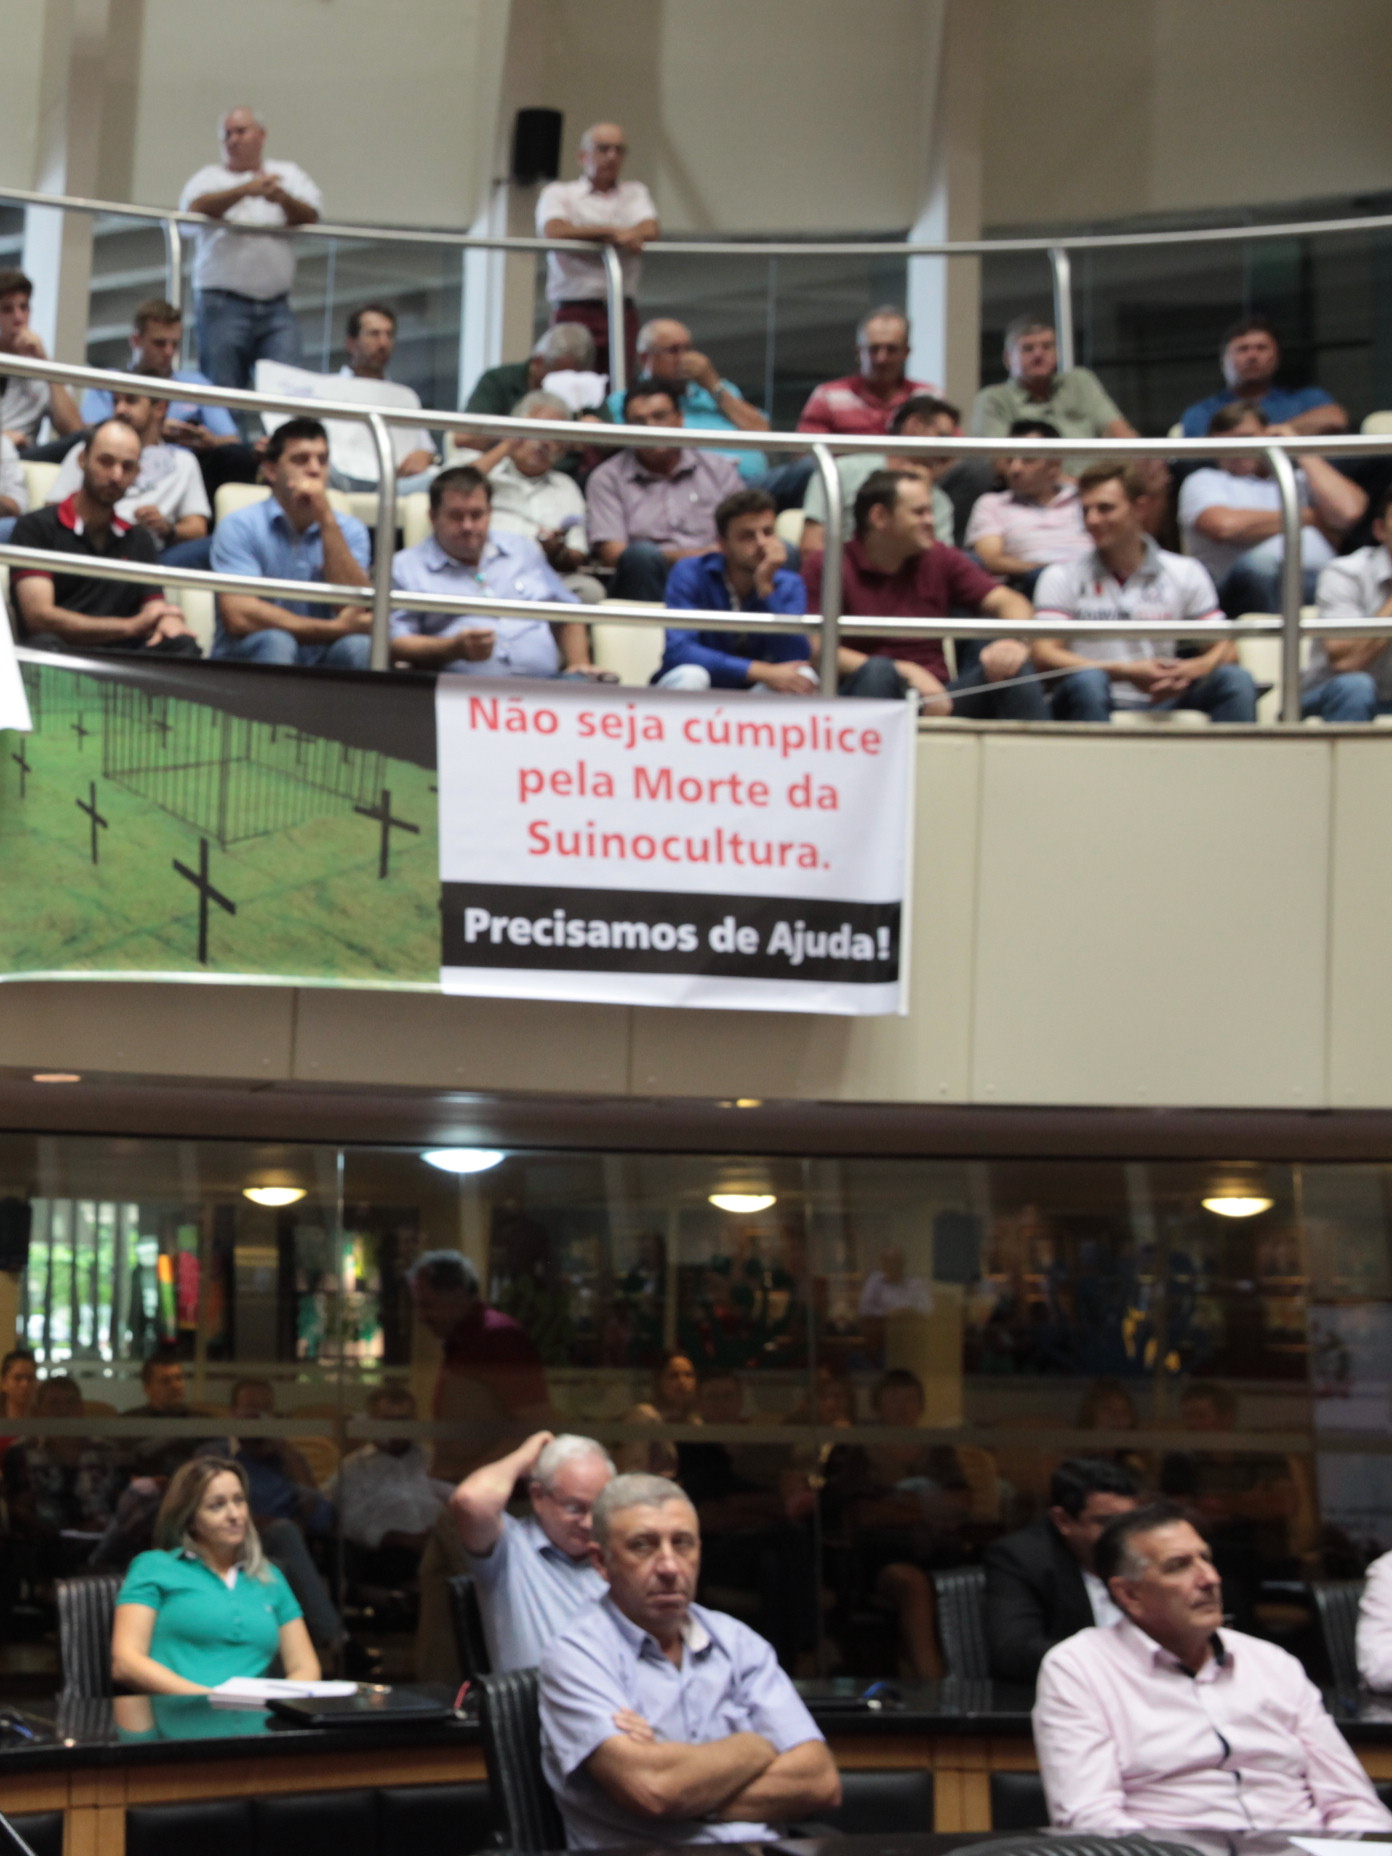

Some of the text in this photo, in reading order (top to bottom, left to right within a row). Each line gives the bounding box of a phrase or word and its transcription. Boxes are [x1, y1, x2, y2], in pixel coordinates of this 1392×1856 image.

[469, 695, 883, 758] Não seja cúmplice
[518, 760, 840, 811] pela Morte da
[527, 820, 831, 870] Suinocultura.
[463, 907, 891, 966] Precisamos de Ajuda!
